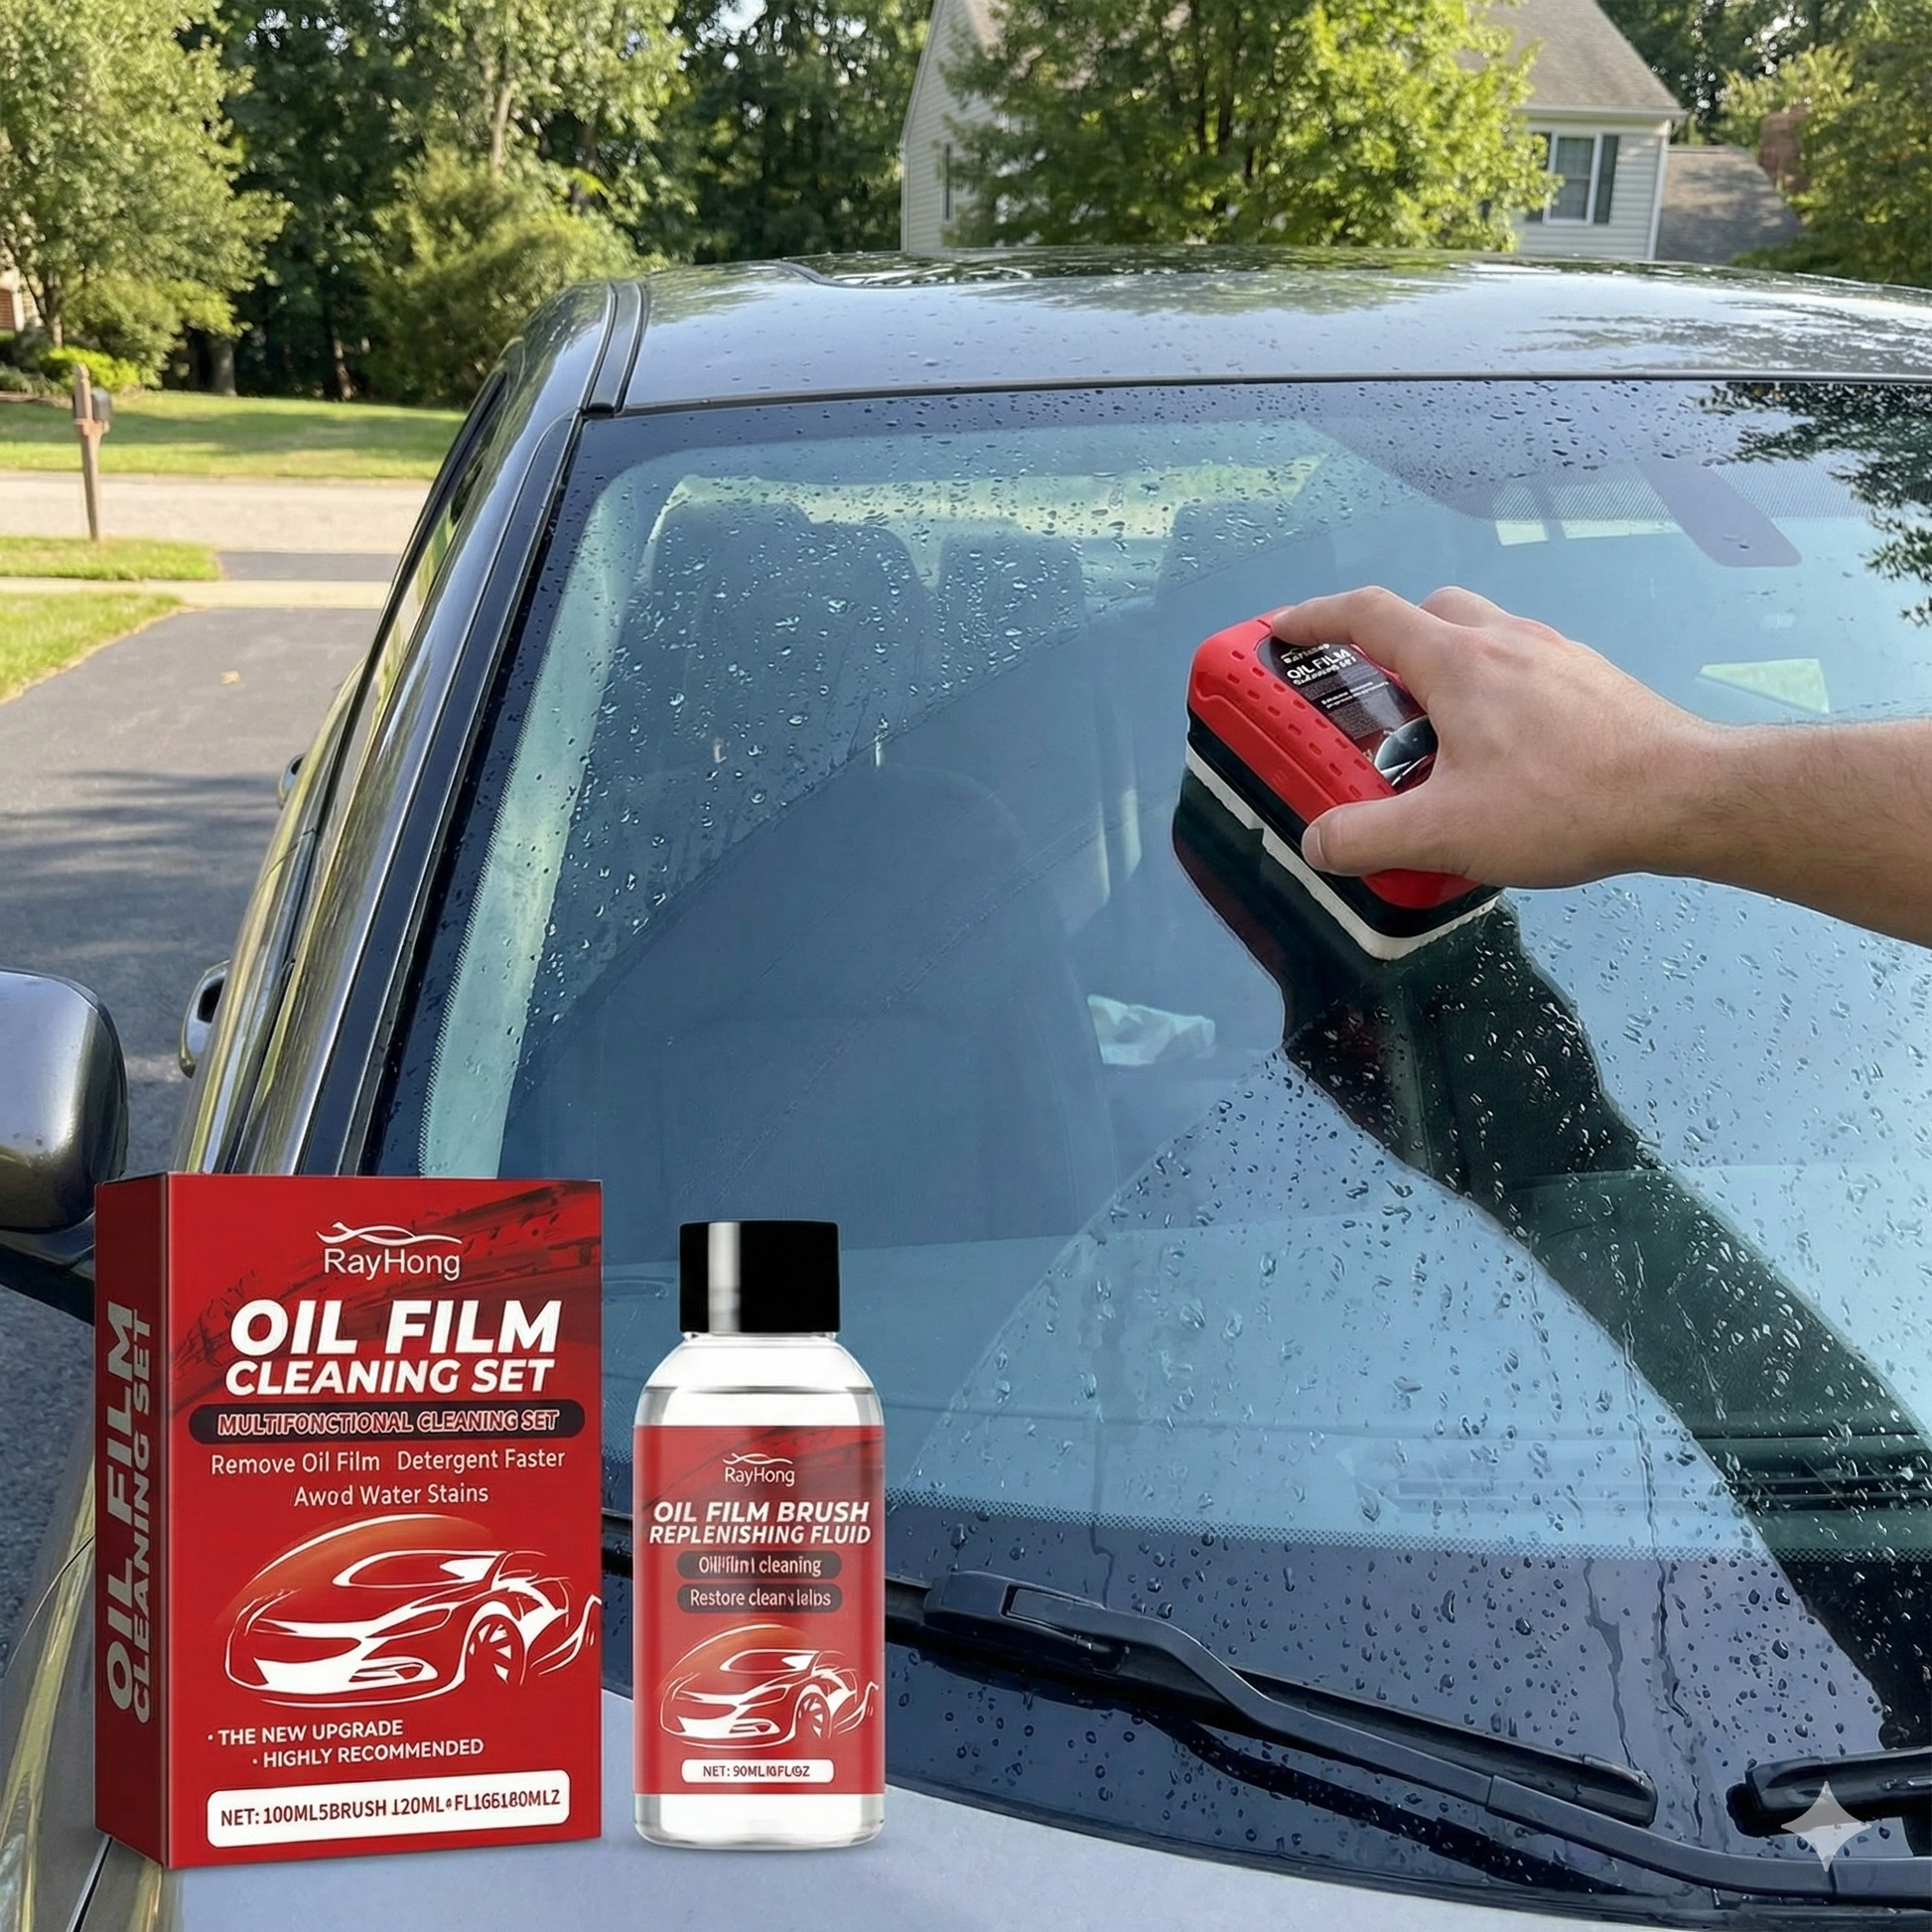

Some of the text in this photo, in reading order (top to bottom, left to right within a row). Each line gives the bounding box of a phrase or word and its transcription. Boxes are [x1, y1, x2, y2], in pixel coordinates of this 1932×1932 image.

[1287, 664, 1315, 679] OIL
[1311, 648, 1351, 670] FILM
[324, 1248, 461, 1281] RayHong
[230, 1299, 562, 1356] OIL FILM
[225, 1358, 555, 1396] CLEANING SET
[217, 1409, 560, 1436] MULTIFONCTIONAL CLEANING SET
[211, 1448, 566, 1475] Remove Oil Film Detergent Faster
[725, 1466, 795, 1486] RayHong
[106, 1301, 133, 1711] OIL FILM
[359, 1485, 421, 1505] Water
[427, 1482, 489, 1503] Stains
[133, 1308, 151, 1725] CLEANING SET
[653, 1501, 870, 1523] OIL FILM BRUSH
[649, 1525, 872, 1545] REPLENISHING FLUID
[759, 1555, 822, 1578] cleaning
[690, 1588, 746, 1606] Restore
[217, 1719, 404, 1745] THE NEW UPGRADE
[263, 1738, 484, 1768] HIGHLY RECOMMENDED
[704, 1765, 731, 1777] NET:
[221, 1808, 259, 1827] NET:
